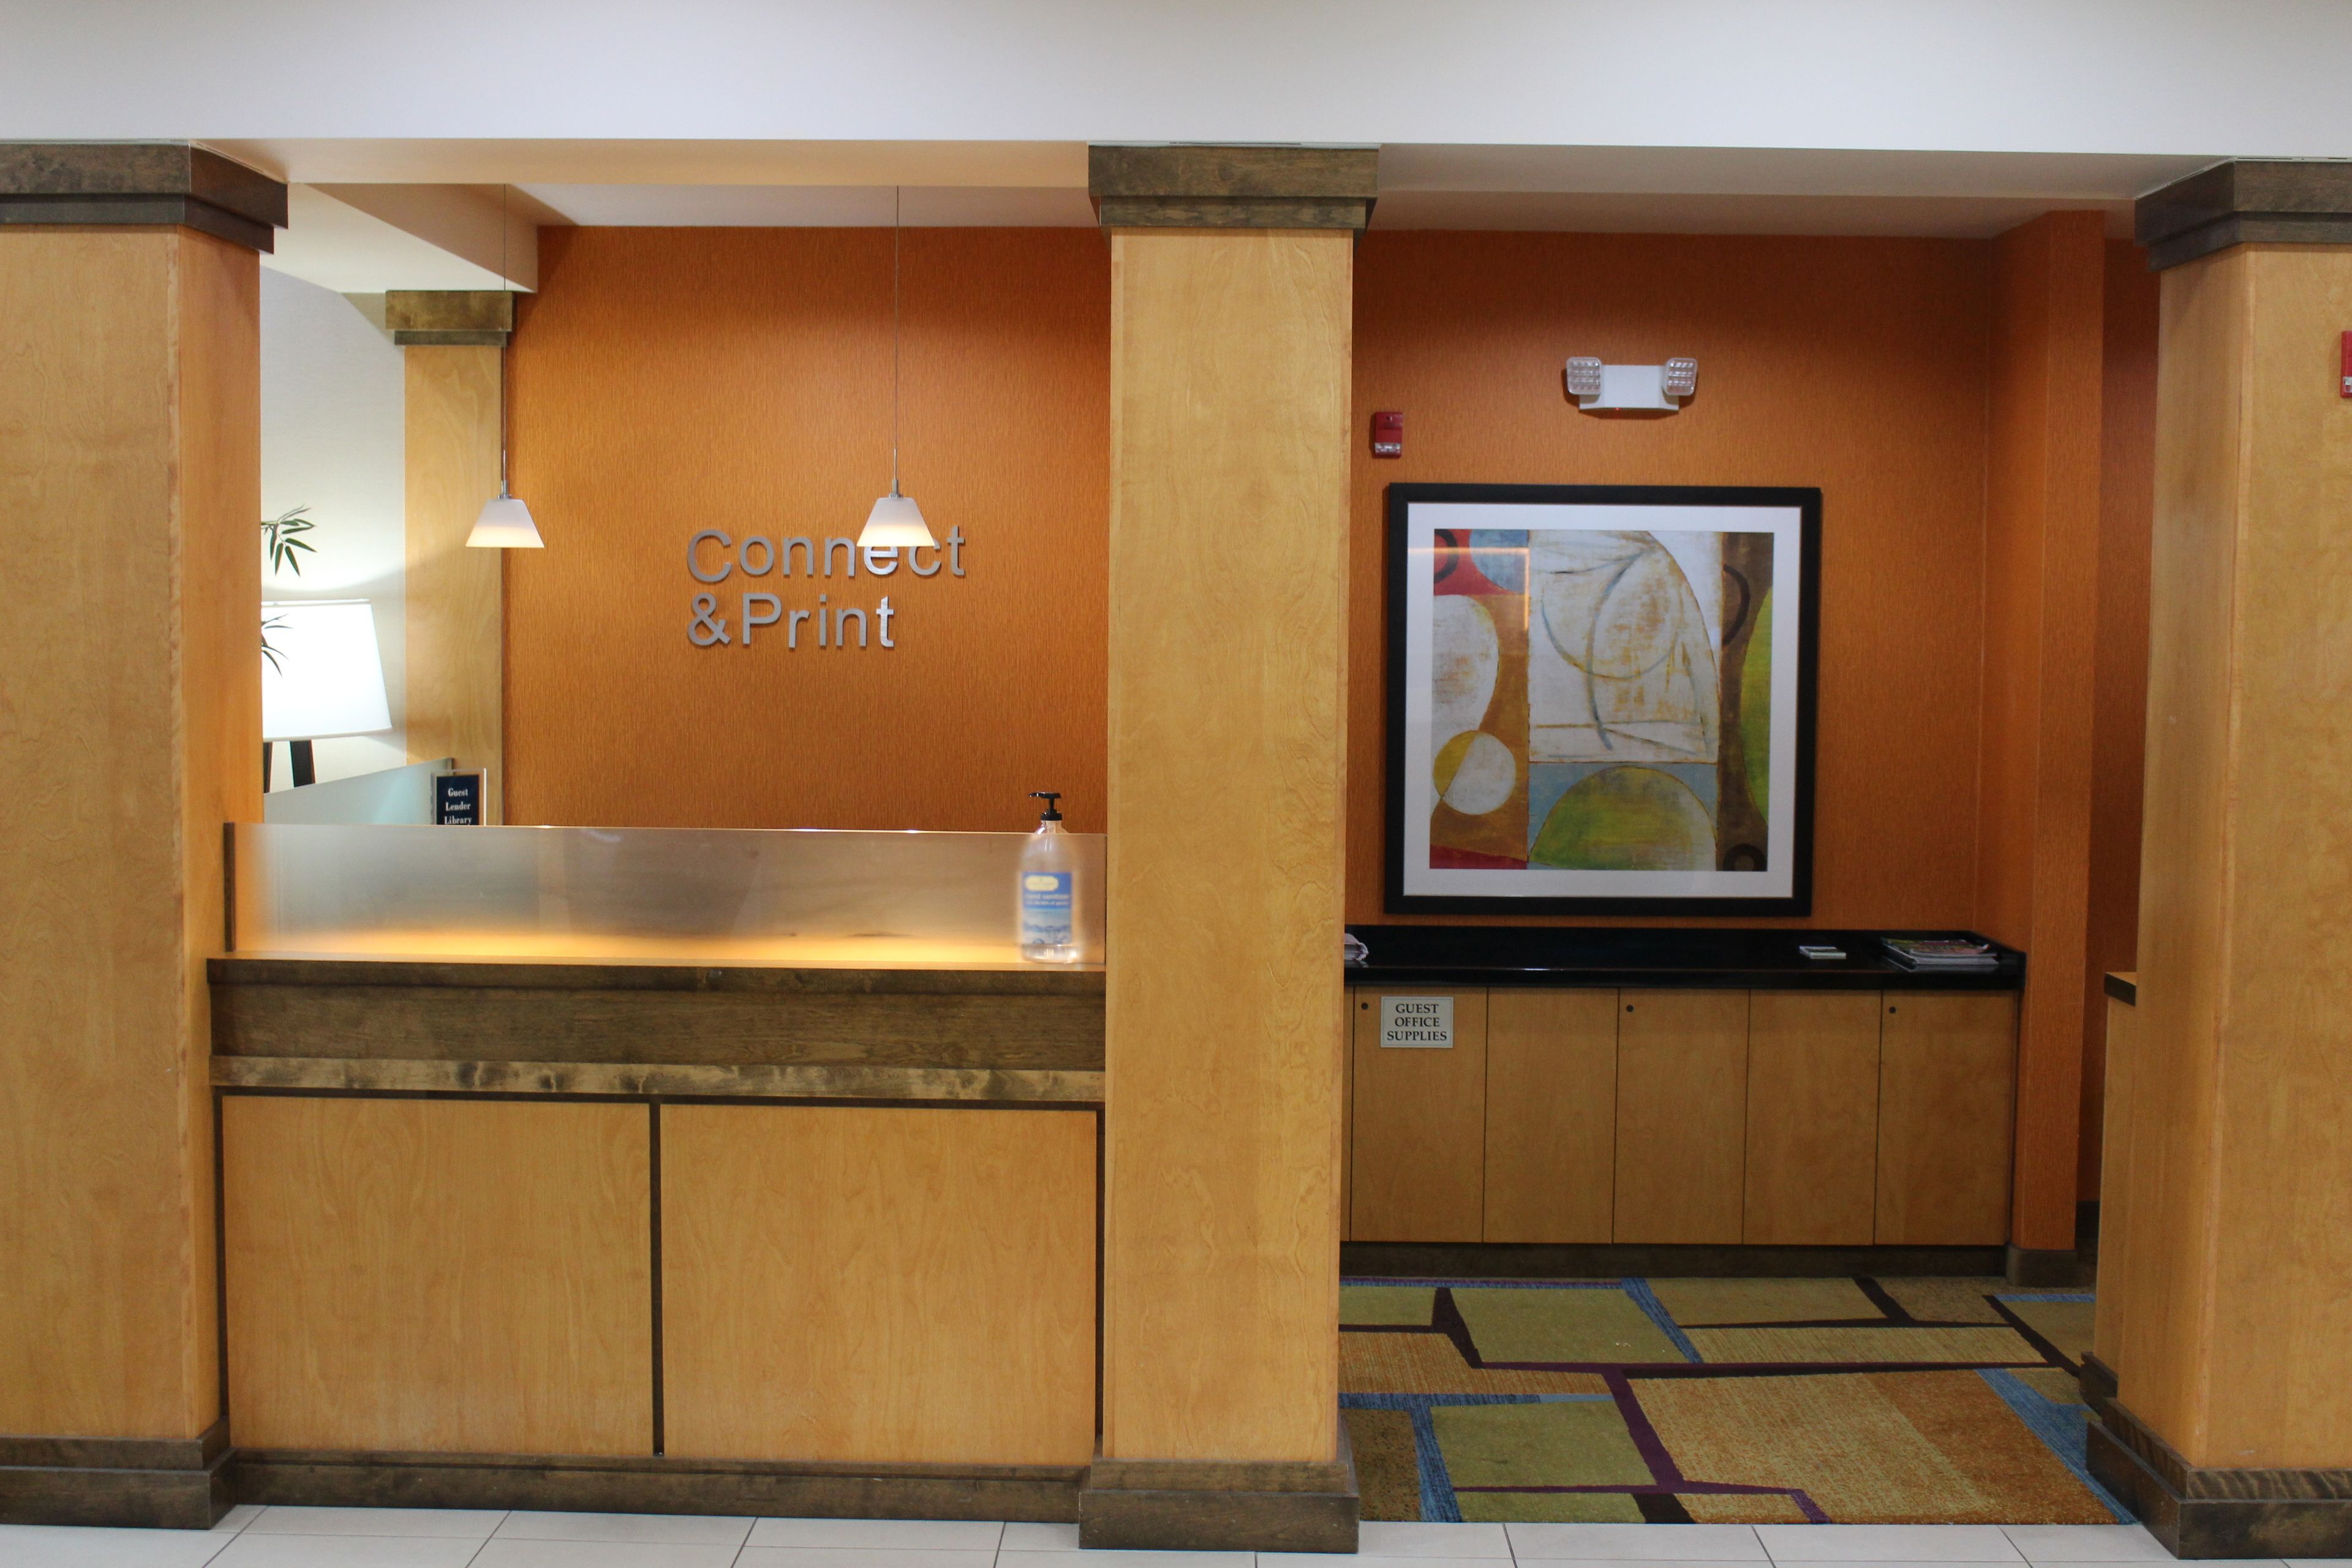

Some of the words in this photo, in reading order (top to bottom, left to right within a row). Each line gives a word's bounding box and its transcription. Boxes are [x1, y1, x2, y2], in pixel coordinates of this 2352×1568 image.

[687, 525, 965, 582] Connect
[448, 788, 468, 797] Guest
[445, 801, 471, 811] Lender
[444, 815, 472, 825] Library
[1395, 1003, 1439, 1014] GUEST
[1395, 1017, 1440, 1027] OFFICE
[1387, 1031, 1447, 1041] SUPPLIES
